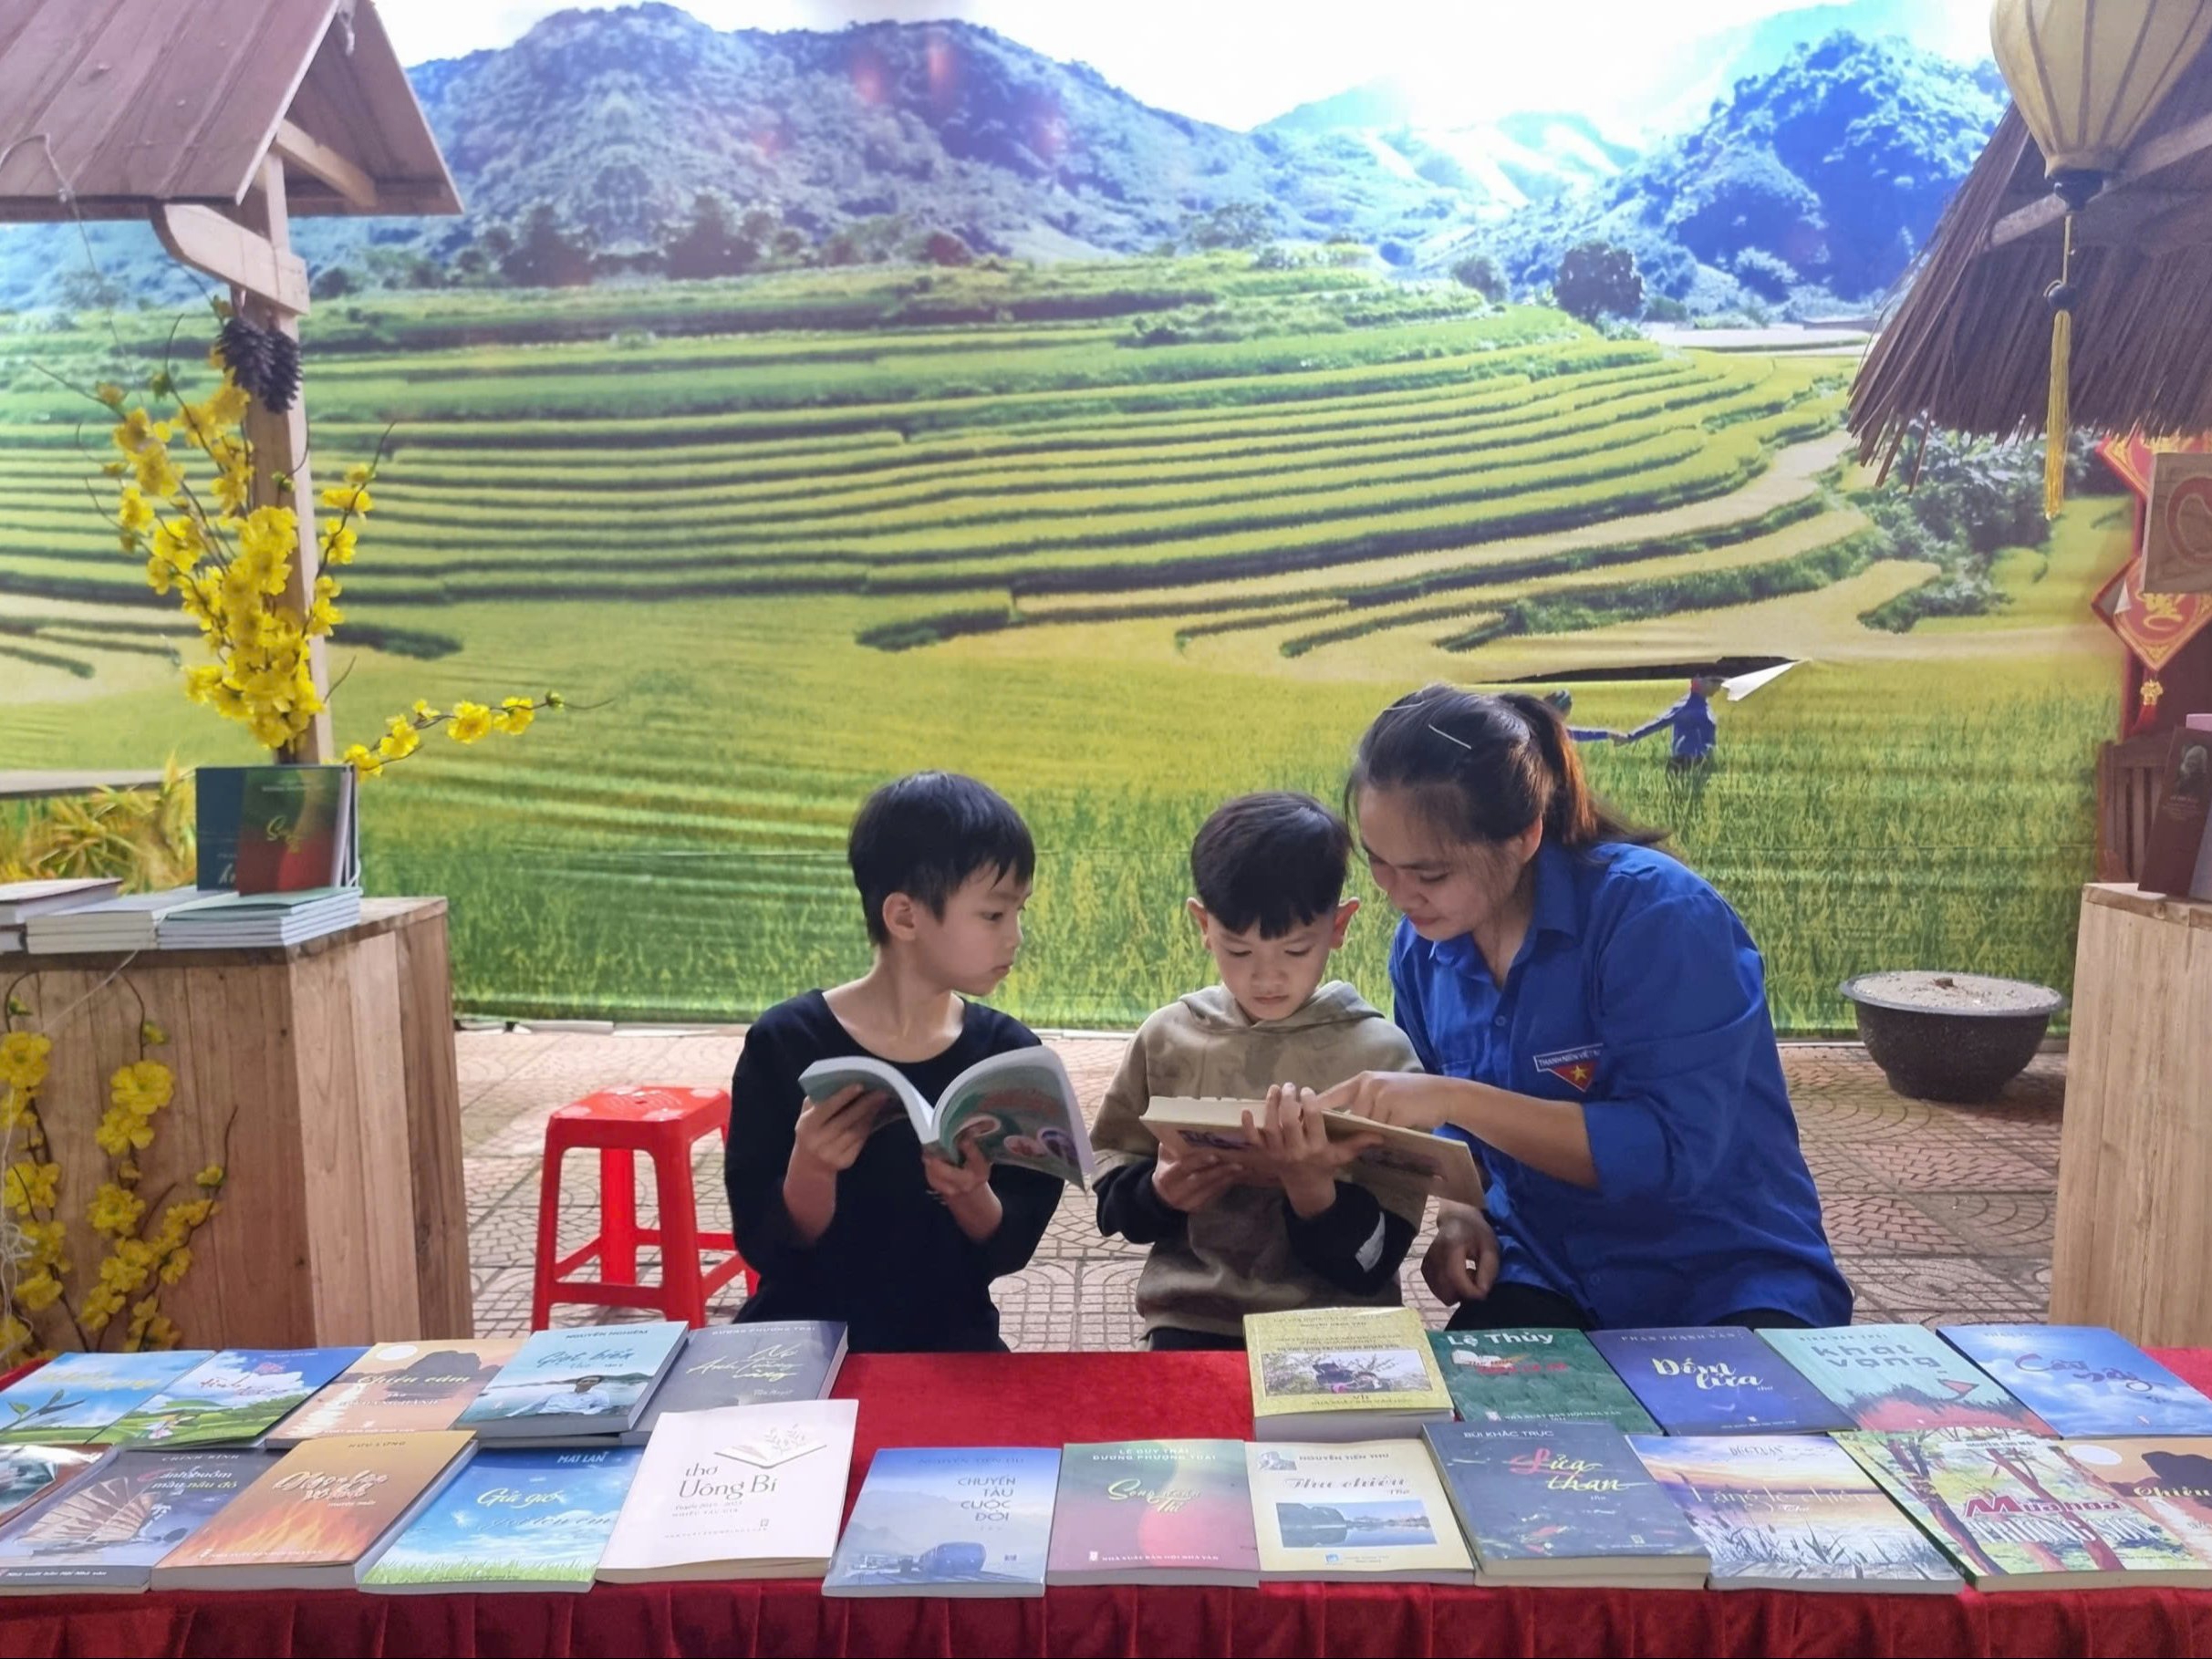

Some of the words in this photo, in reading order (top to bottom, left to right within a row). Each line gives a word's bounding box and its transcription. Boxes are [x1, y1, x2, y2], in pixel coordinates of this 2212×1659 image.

[557, 1454, 582, 1464] MAI
[685, 1462, 719, 1478] thơ
[678, 1479, 746, 1500] Uông
[750, 1474, 779, 1494] Bí
